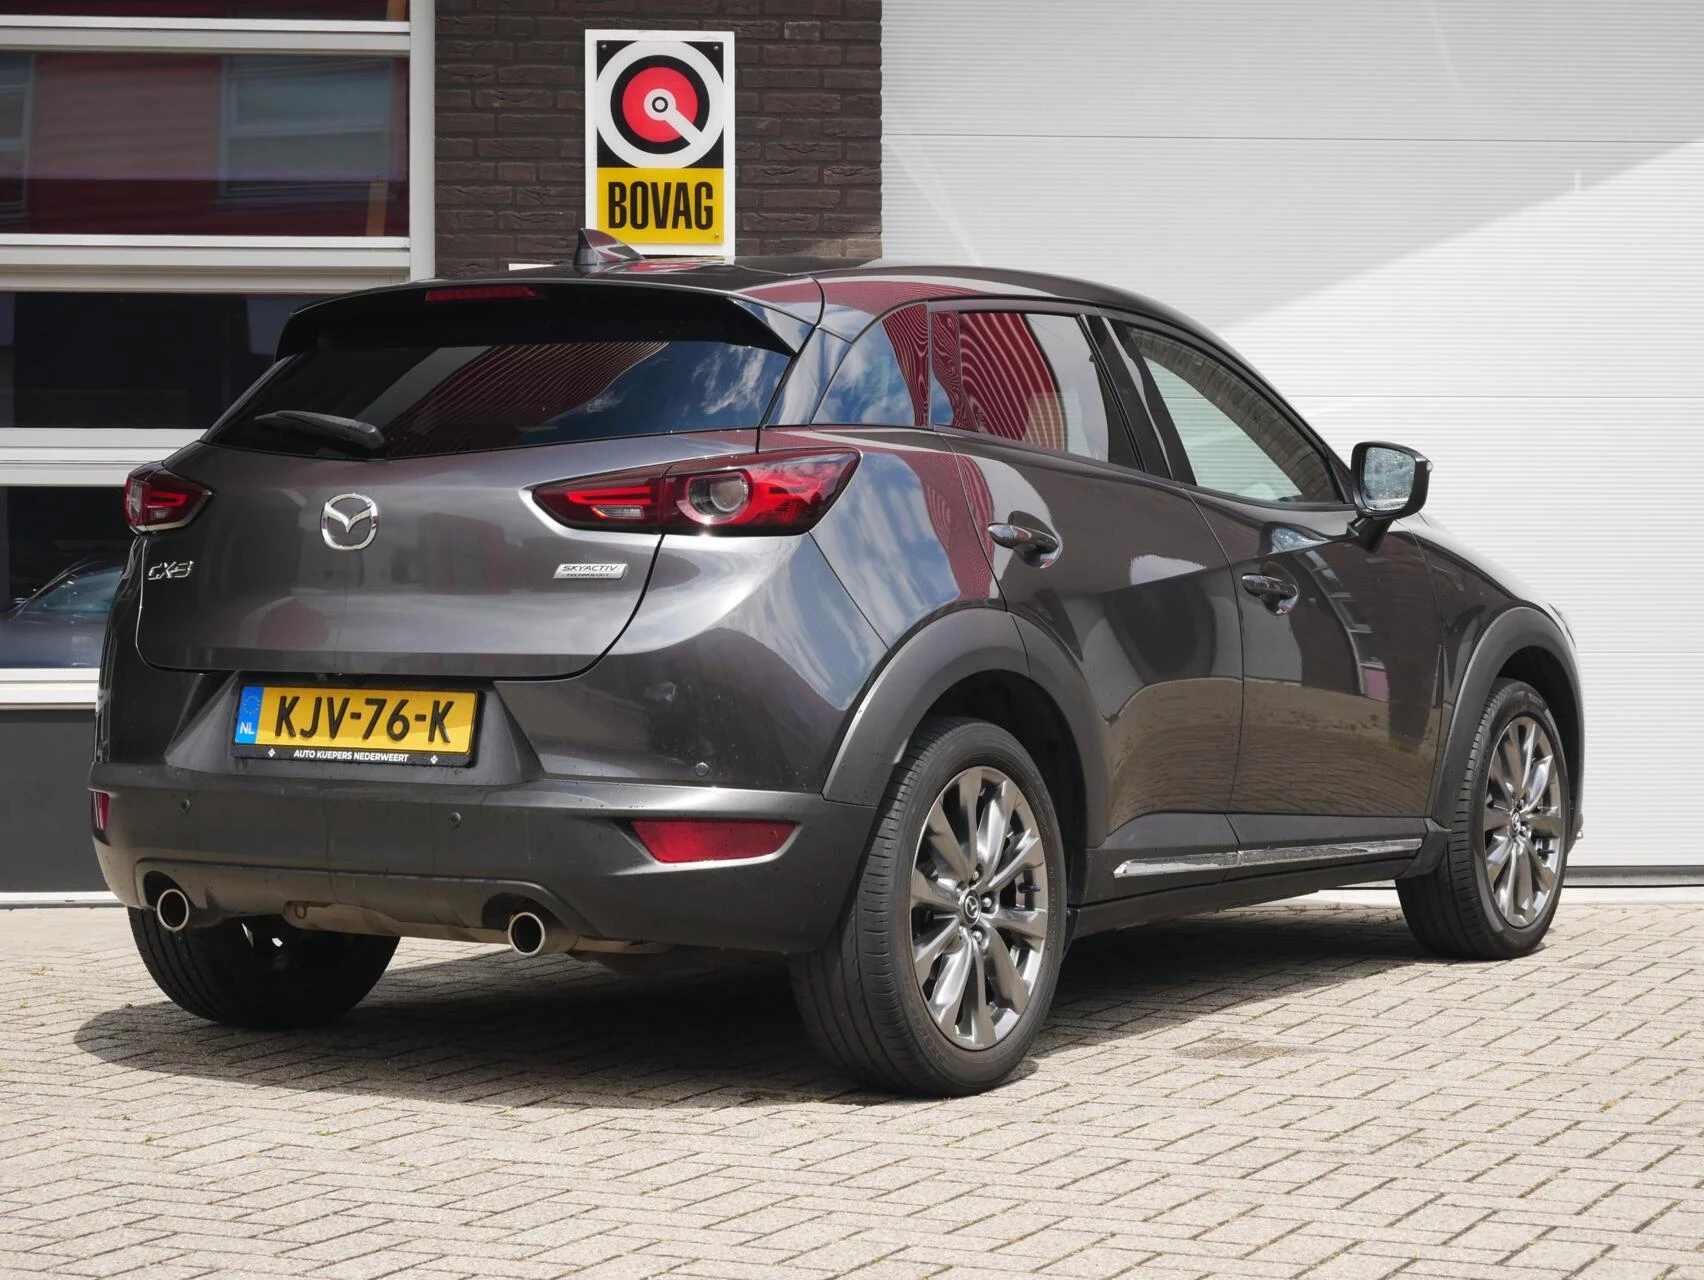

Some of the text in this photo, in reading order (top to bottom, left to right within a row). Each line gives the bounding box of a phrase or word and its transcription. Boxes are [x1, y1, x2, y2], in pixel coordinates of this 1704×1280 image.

[608, 181, 714, 230] BOVAG
[239, 721, 255, 735] NL
[274, 695, 455, 744] KJV-76-K
[293, 749, 410, 763] AUTO KUEPERS NEDERWEERT
